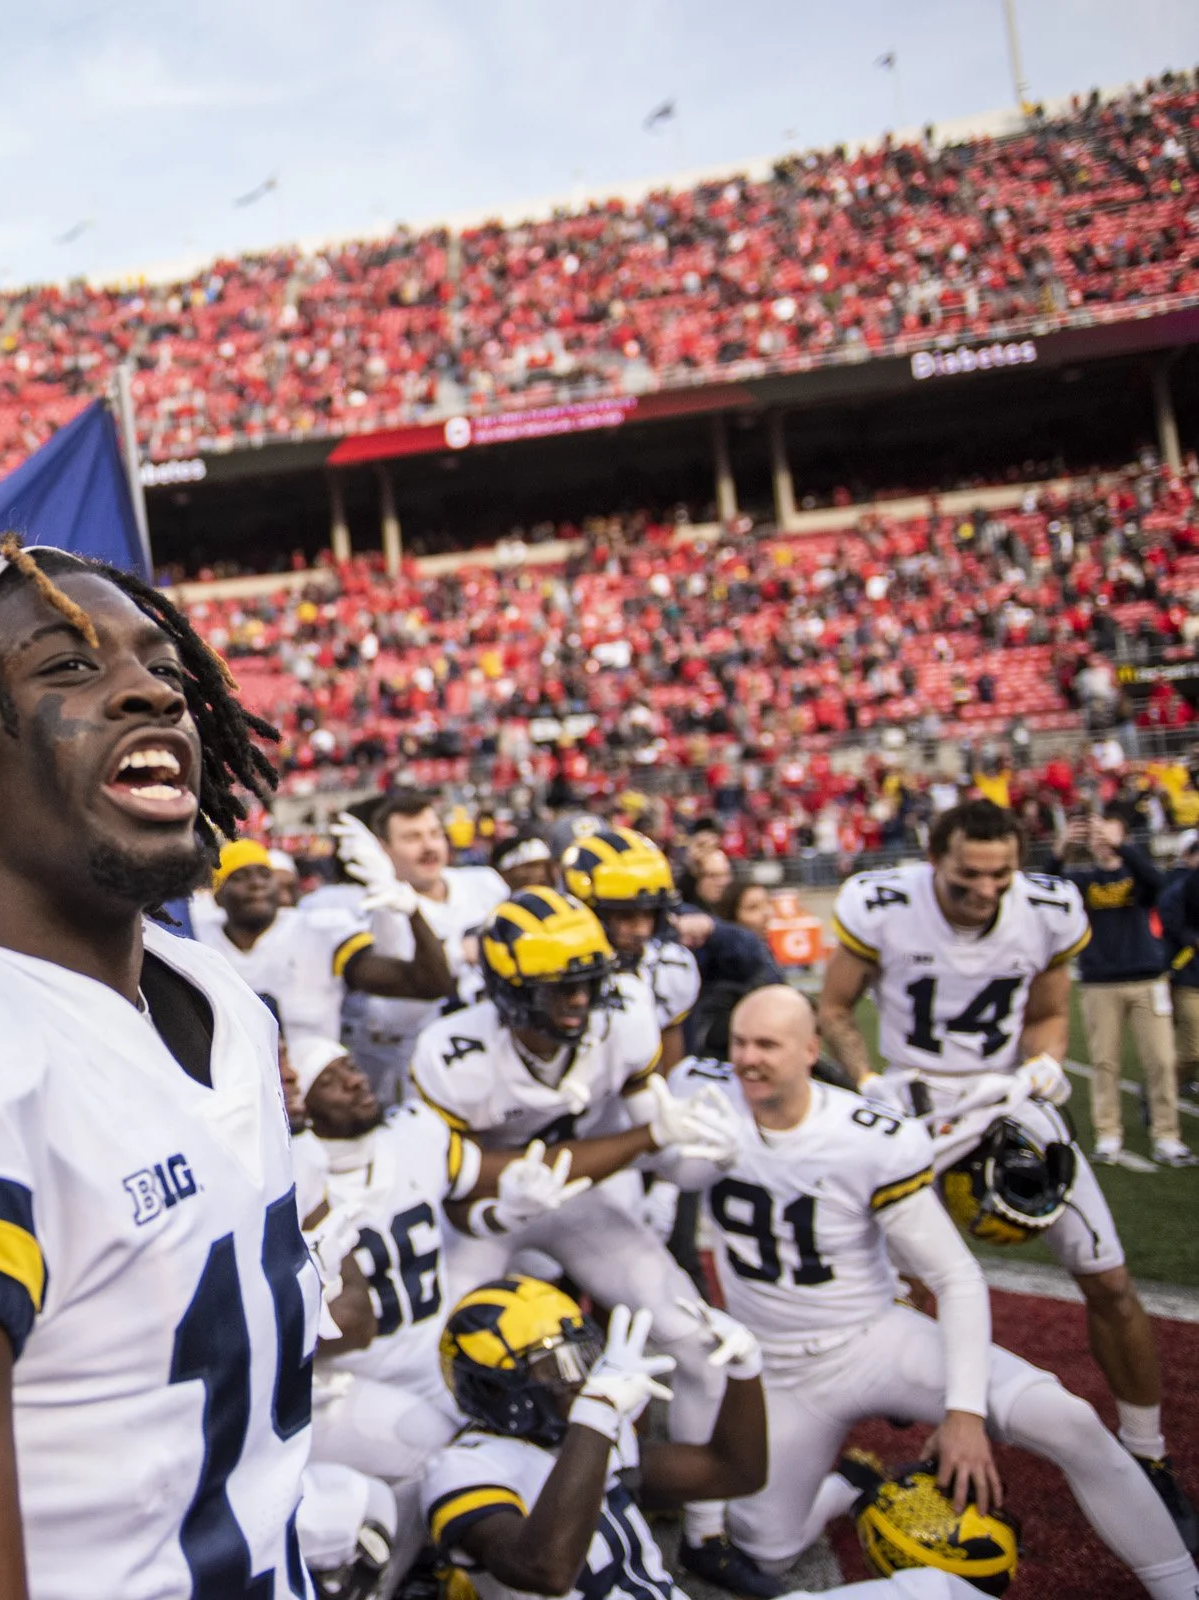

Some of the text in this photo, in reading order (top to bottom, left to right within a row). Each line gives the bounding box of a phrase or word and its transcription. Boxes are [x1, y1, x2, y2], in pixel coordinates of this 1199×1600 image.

[442, 1035, 485, 1066] 4
[906, 975, 1024, 1059] 14
[351, 1202, 442, 1336] 86
[711, 1177, 836, 1285] 91
